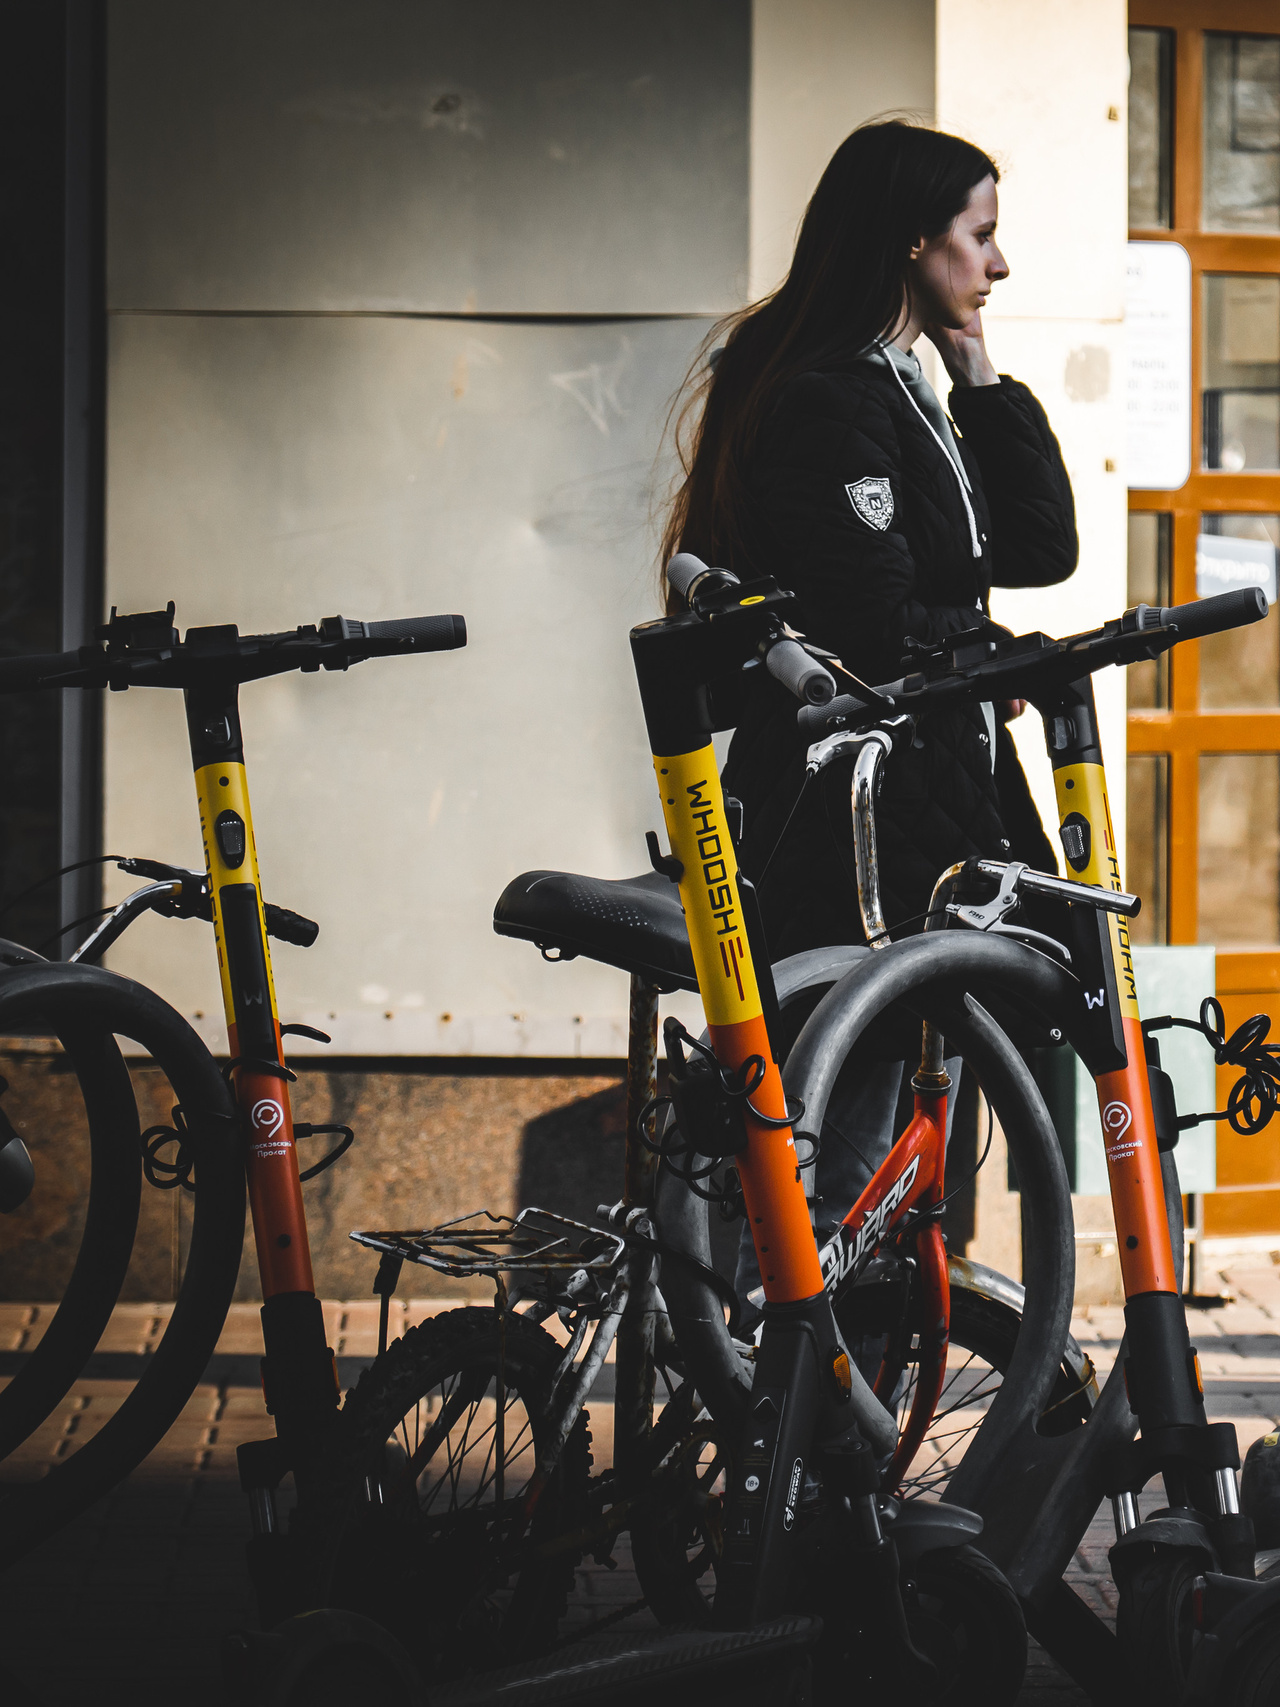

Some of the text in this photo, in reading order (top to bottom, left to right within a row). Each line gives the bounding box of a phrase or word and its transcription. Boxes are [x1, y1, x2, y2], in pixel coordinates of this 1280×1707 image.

[686, 780, 738, 936] WHOOSH
[1107, 1140, 1143, 1153] осковский
[1109, 1150, 1135, 1162] Прокат
[822, 1154, 920, 1292] RWARD
[747, 1479, 758, 1488] 18+
